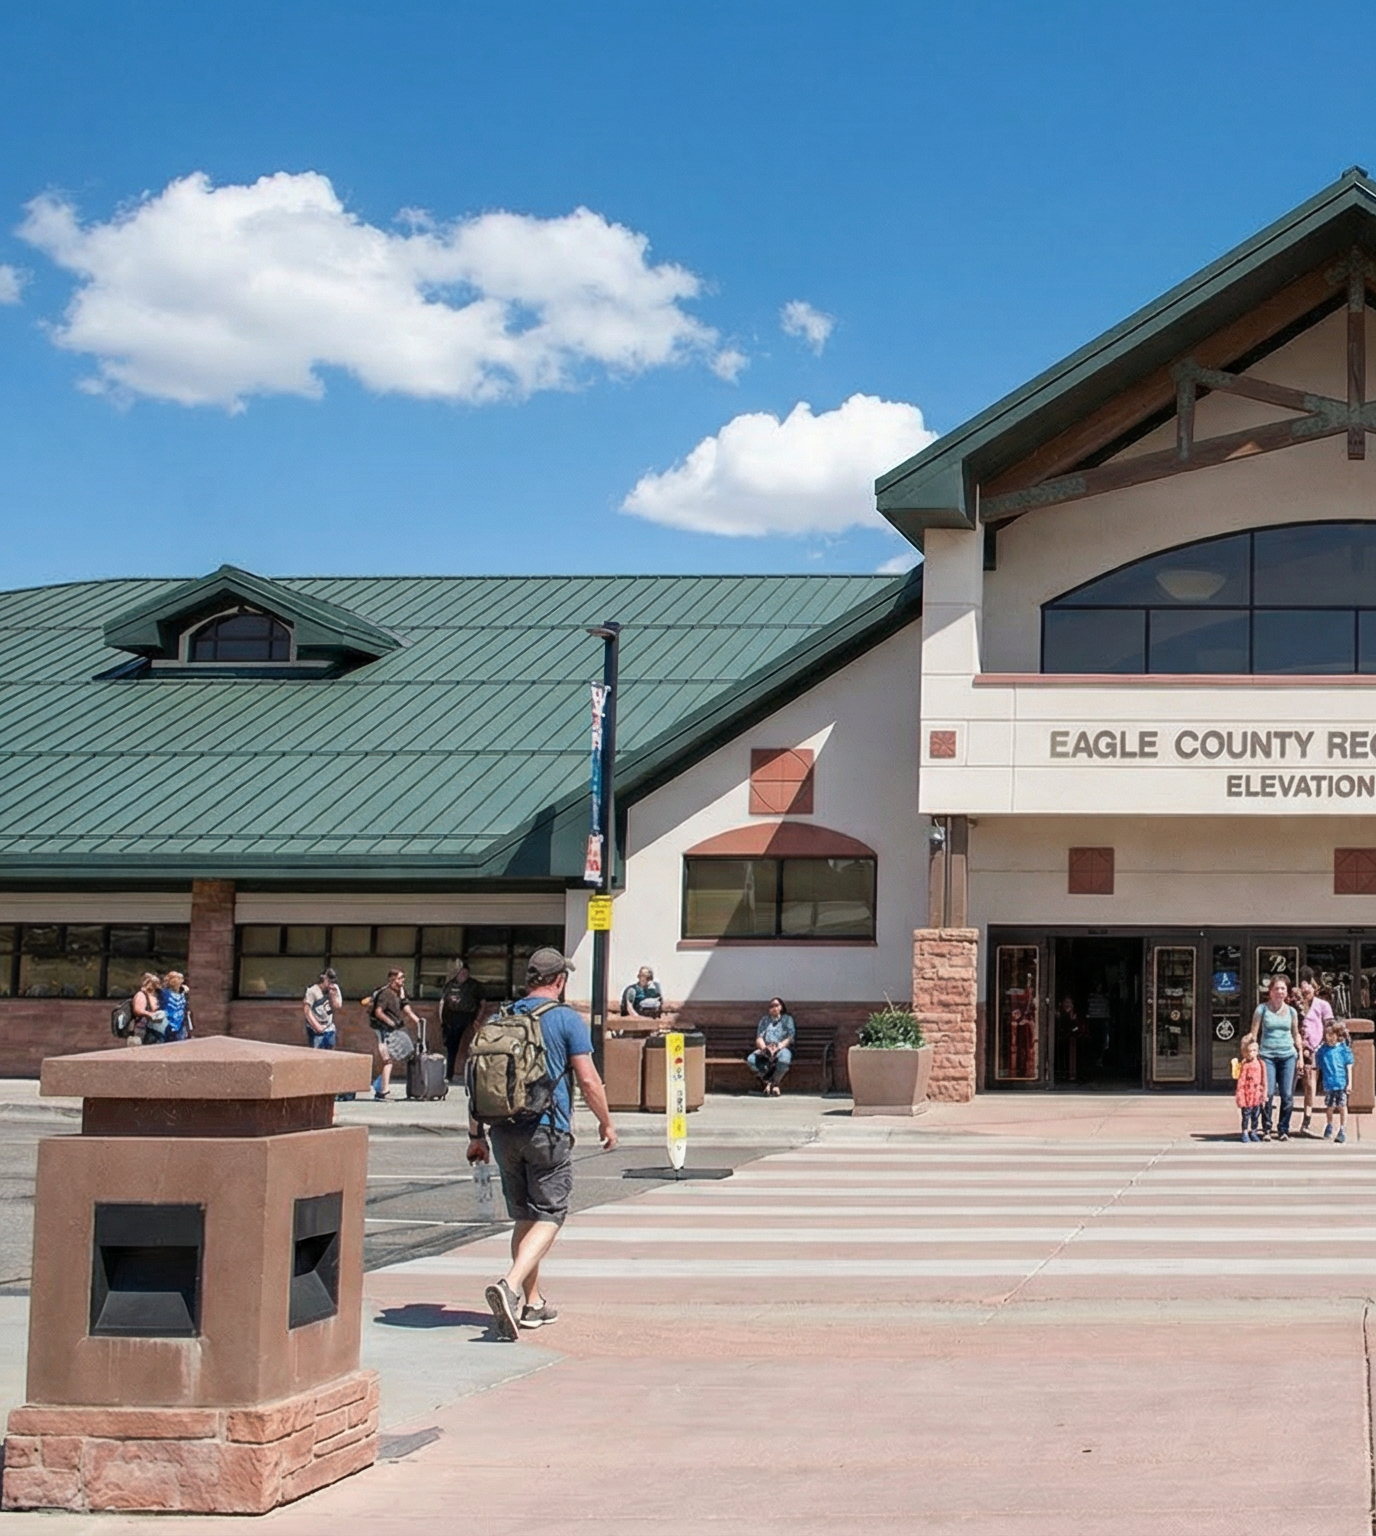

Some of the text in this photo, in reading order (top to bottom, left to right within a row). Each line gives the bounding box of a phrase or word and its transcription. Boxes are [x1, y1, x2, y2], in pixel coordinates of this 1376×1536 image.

[1050, 730, 1159, 759] EAGLE
[1174, 729, 1315, 760] COUNTY
[1226, 774, 1376, 798] ELEVATION
